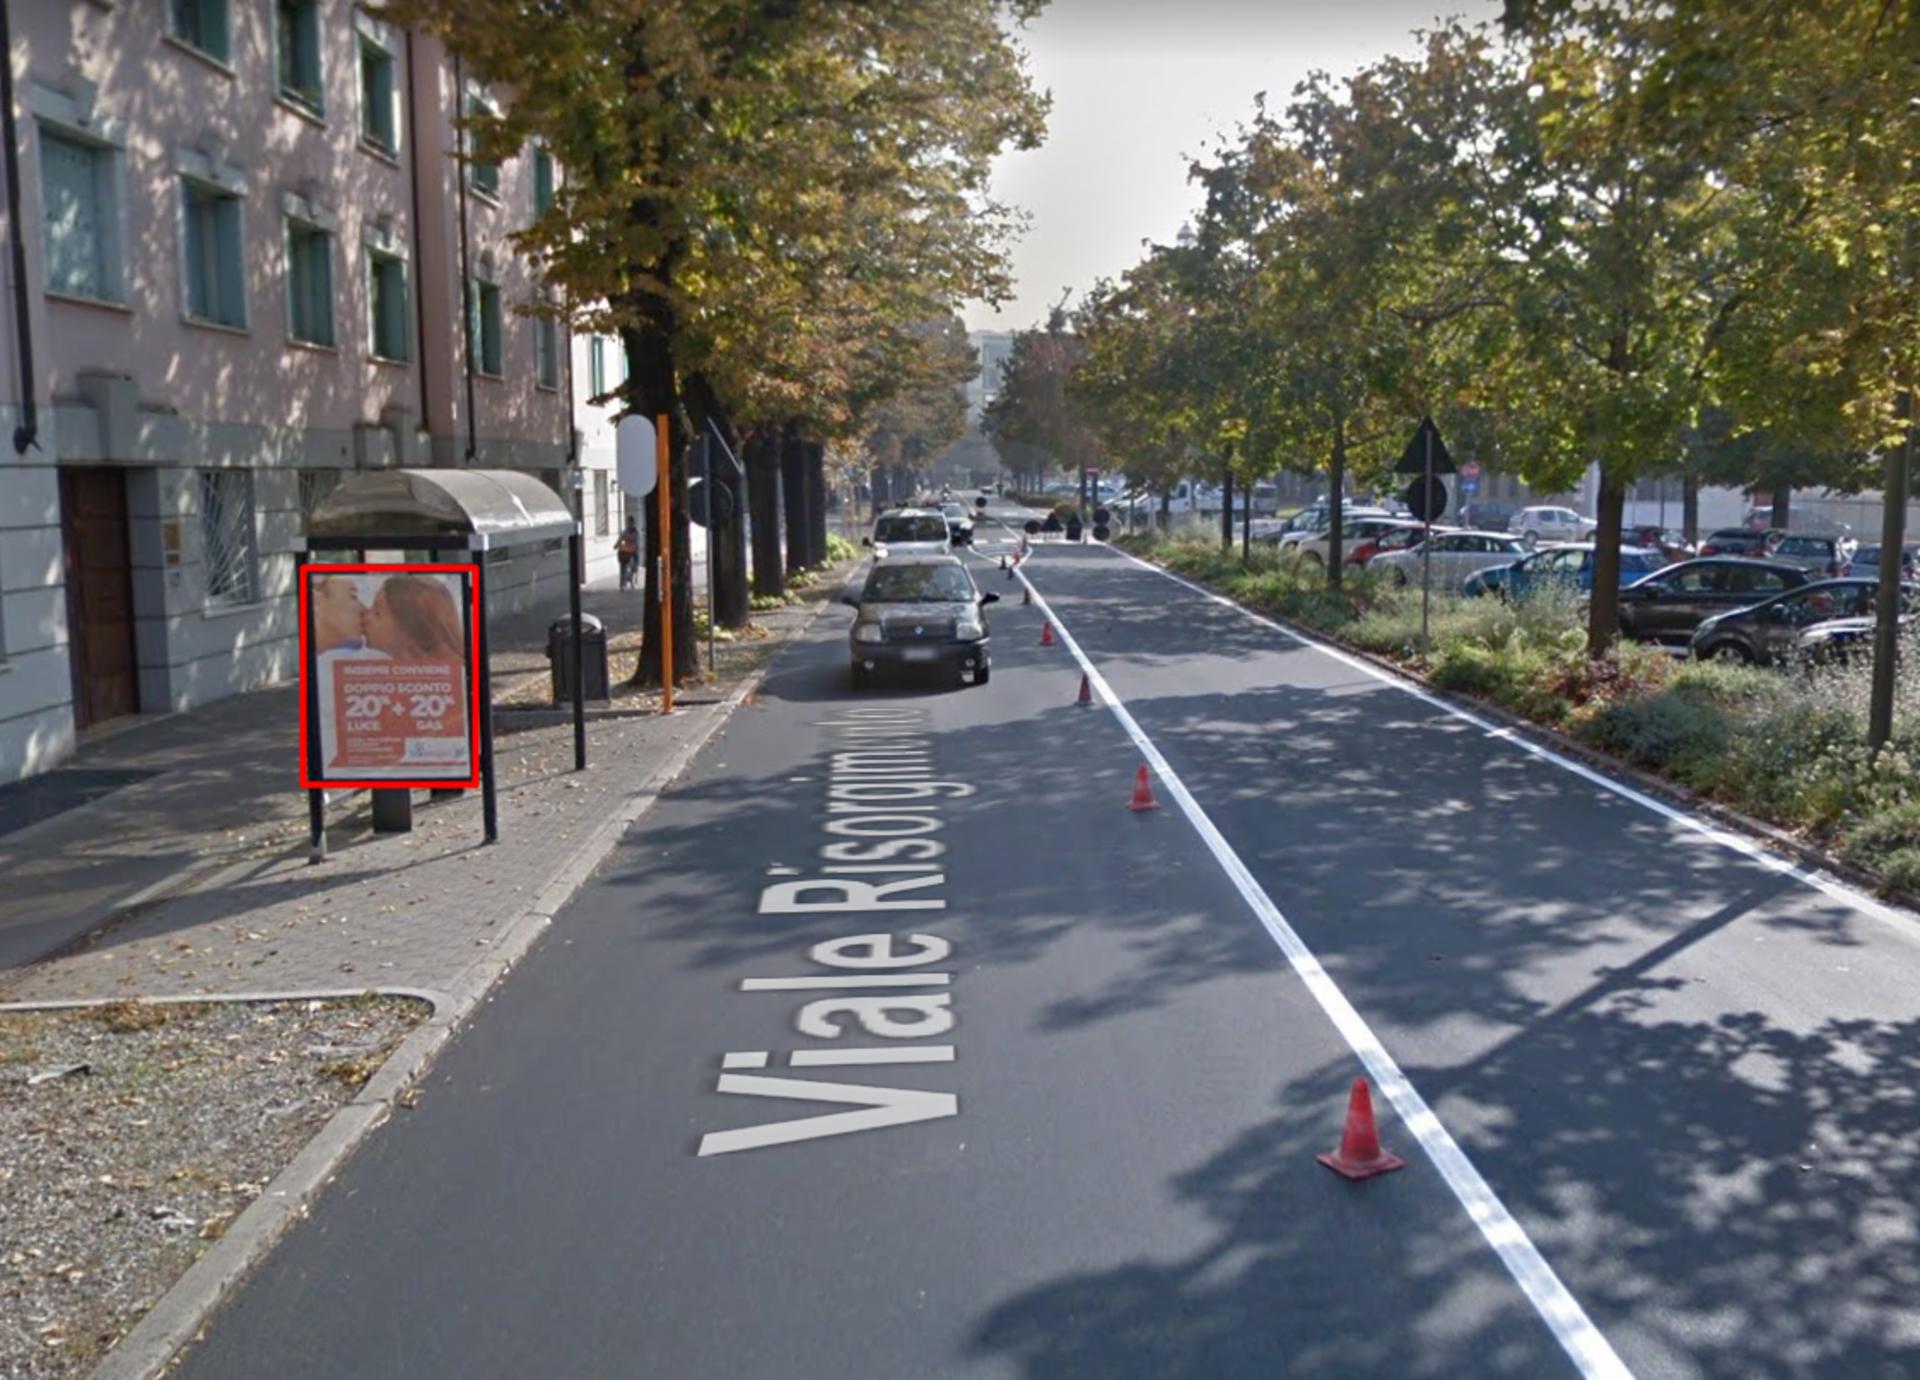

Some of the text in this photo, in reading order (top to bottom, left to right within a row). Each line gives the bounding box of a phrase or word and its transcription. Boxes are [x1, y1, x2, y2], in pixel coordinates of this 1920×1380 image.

[392, 665, 450, 675] CONVIENE
[343, 682, 451, 693] DOPPIO SCONTO
[346, 720, 443, 732] LUCE GAS
